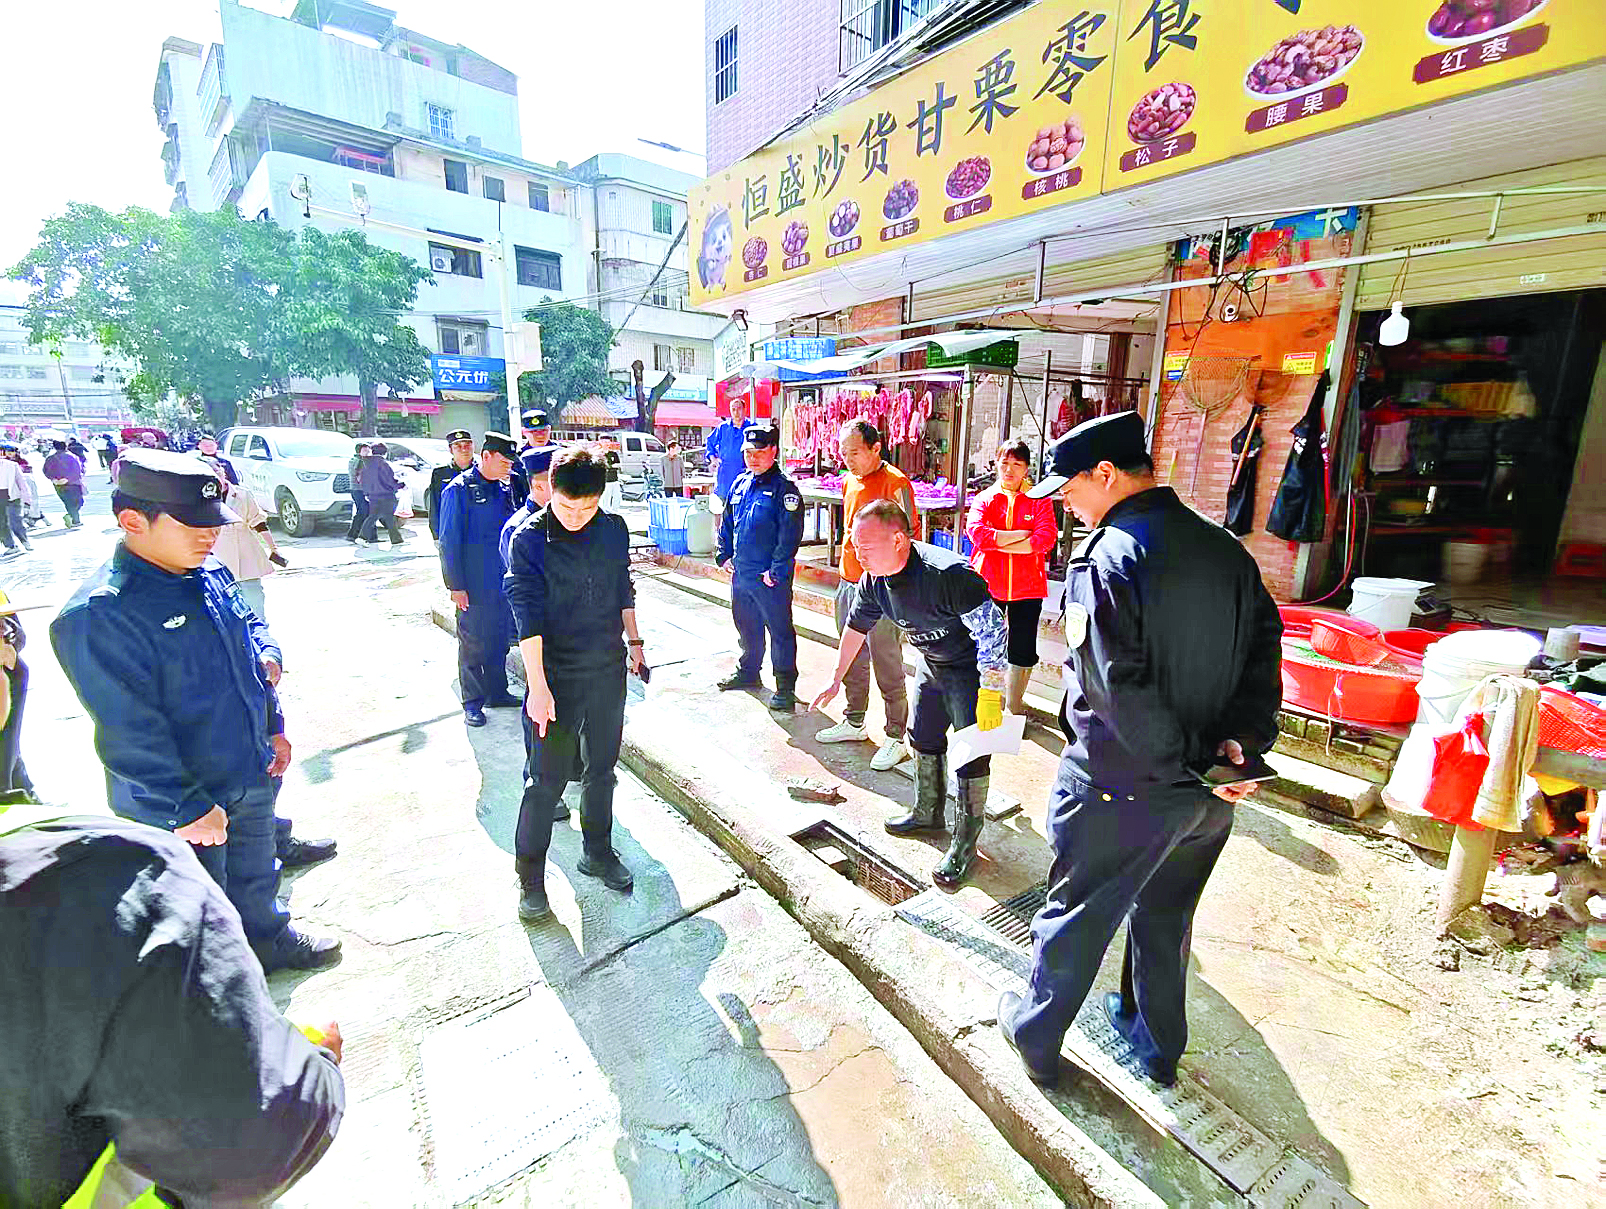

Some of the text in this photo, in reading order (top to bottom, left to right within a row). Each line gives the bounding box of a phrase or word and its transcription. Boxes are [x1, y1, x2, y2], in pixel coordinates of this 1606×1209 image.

[1439, 36, 1510, 76] 红枣
[741, 0, 1301, 231] 恒盛炒货甘栗零食
[1265, 92, 1325, 128] 腰果
[1134, 139, 1179, 166] 松子
[1033, 173, 1069, 196] 核桃
[953, 199, 983, 219] 桃仁
